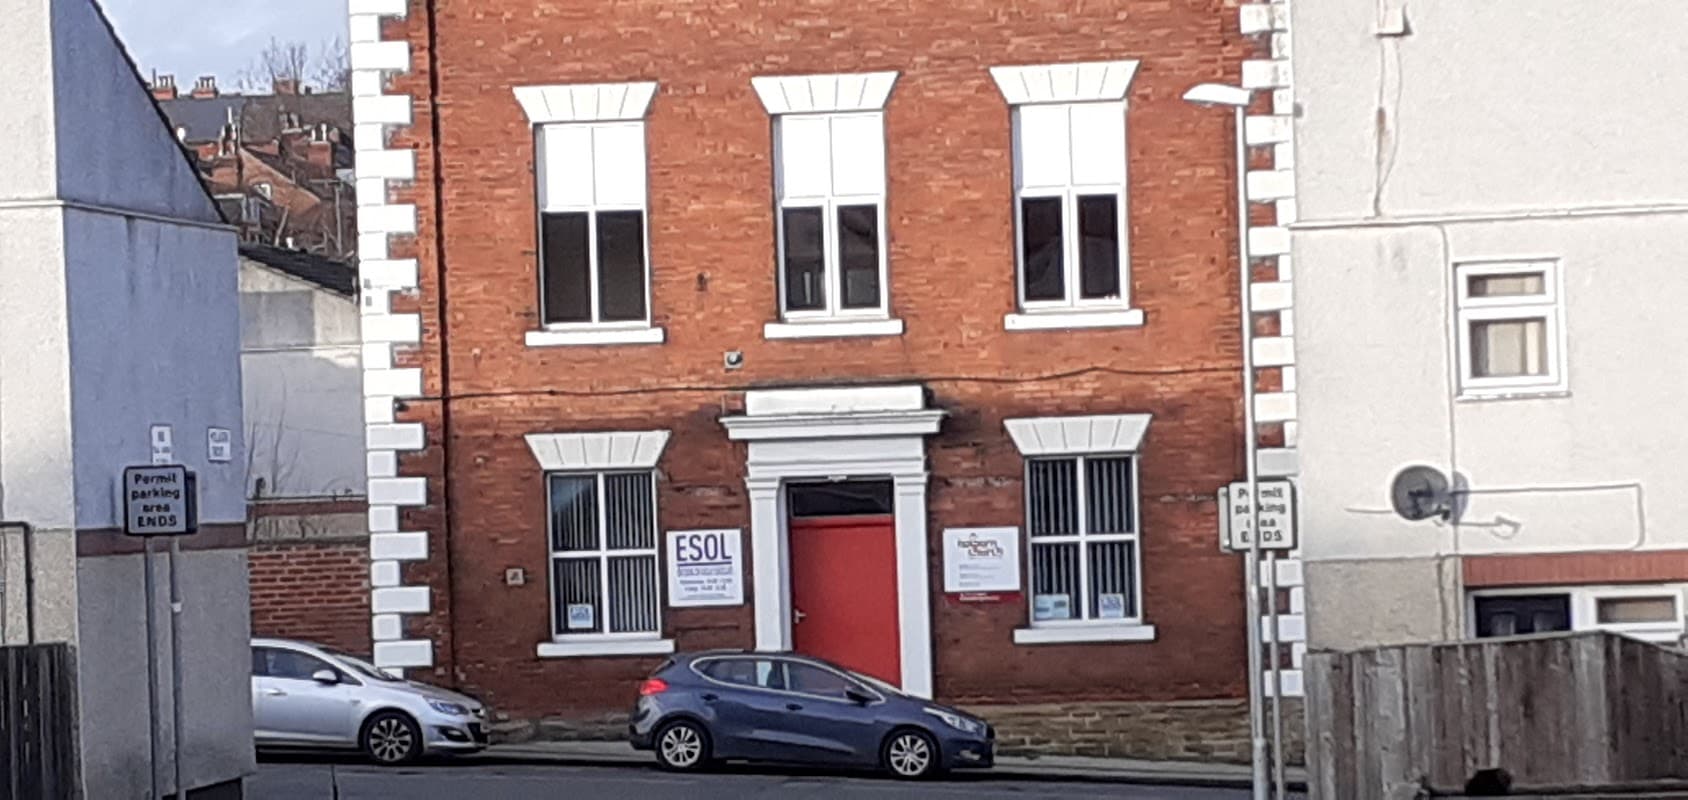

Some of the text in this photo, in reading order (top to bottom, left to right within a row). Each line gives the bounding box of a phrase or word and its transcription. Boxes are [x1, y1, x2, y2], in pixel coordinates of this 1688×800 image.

[134, 473, 177, 485] Permit
[131, 487, 180, 501] parking
[1238, 487, 1283, 498] Pmit
[142, 503, 170, 513] area
[1235, 503, 1286, 515] paking
[137, 514, 177, 528] ENDS
[1240, 530, 1283, 543] EDS
[676, 533, 733, 562] ESOL
